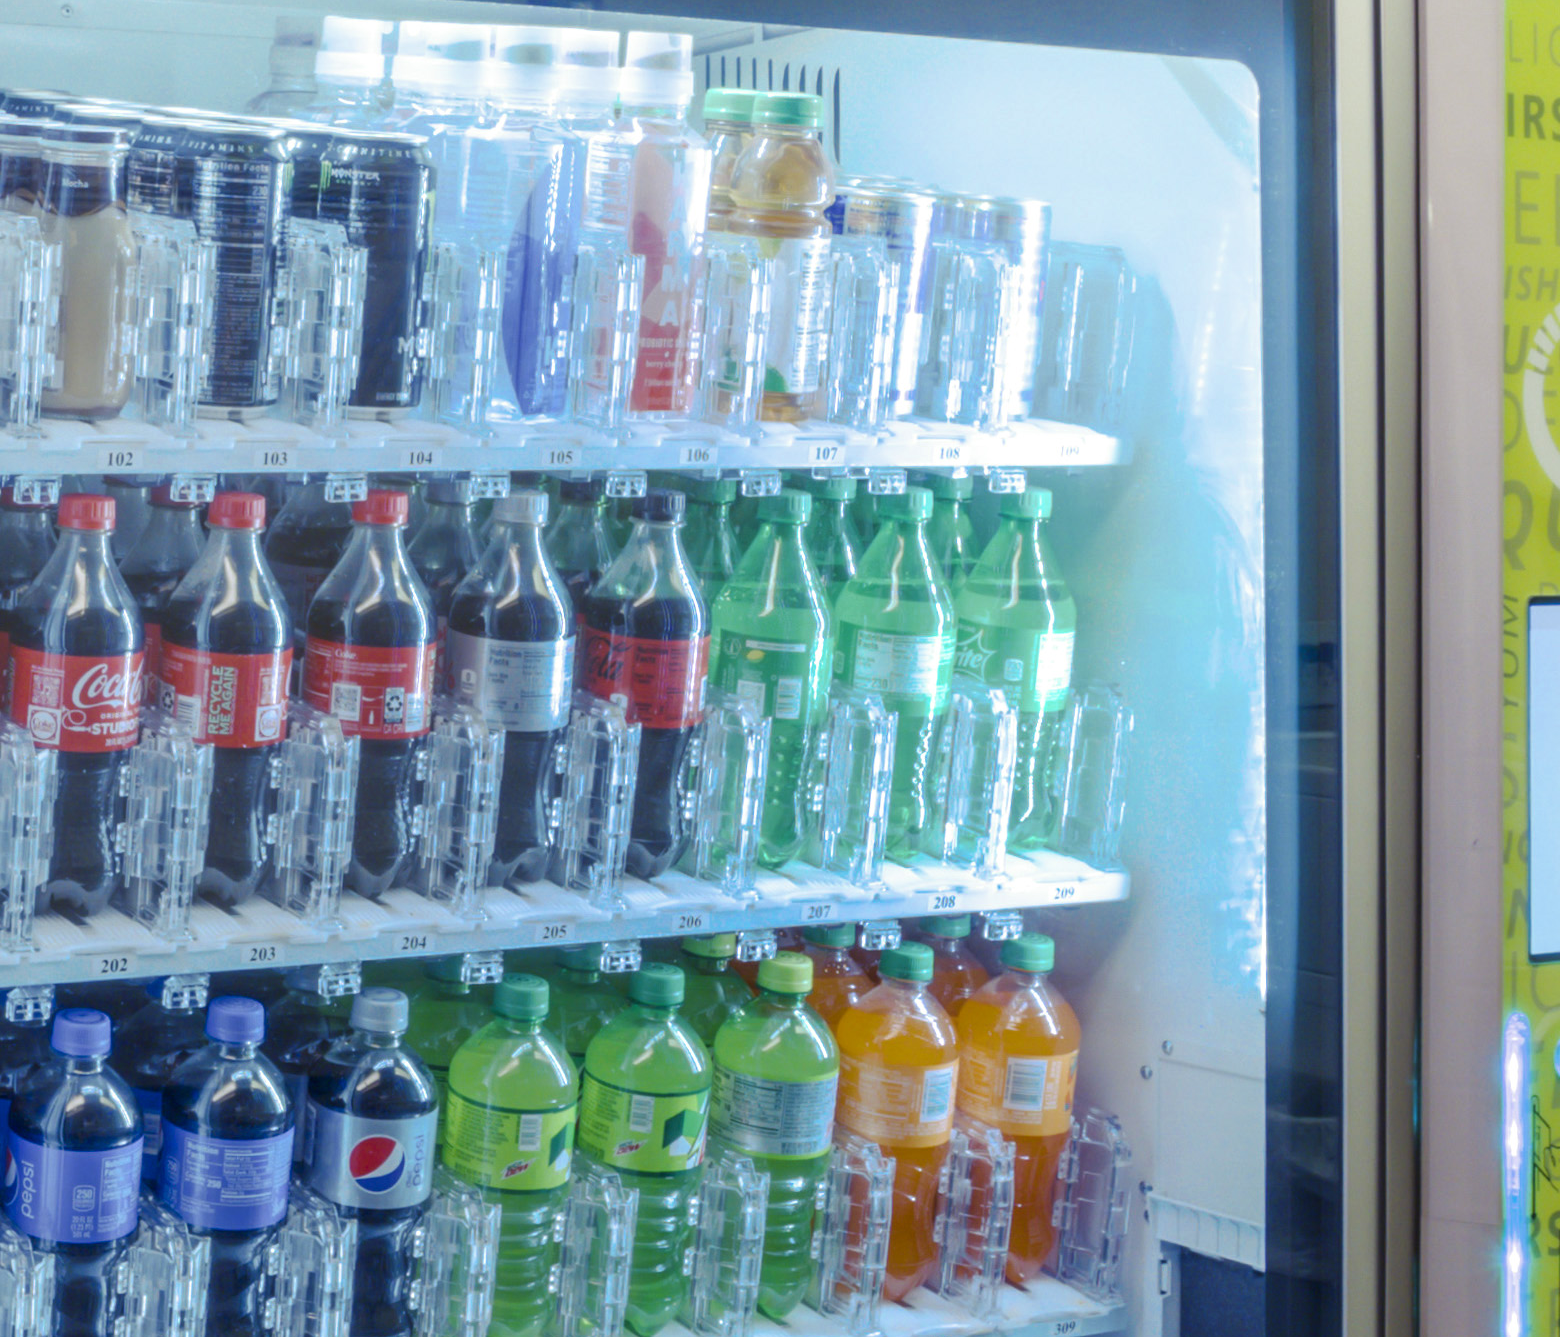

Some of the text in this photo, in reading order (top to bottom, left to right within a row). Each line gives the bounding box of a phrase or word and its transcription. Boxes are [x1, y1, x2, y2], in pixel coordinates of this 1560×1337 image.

[262, 451, 289, 466] 103
[1053, 886, 1076, 901] 209
[541, 924, 568, 940] 205
[249, 946, 277, 963] 203
[19, 1159, 36, 1220] pepsi
[1053, 1320, 1077, 1336] 309
